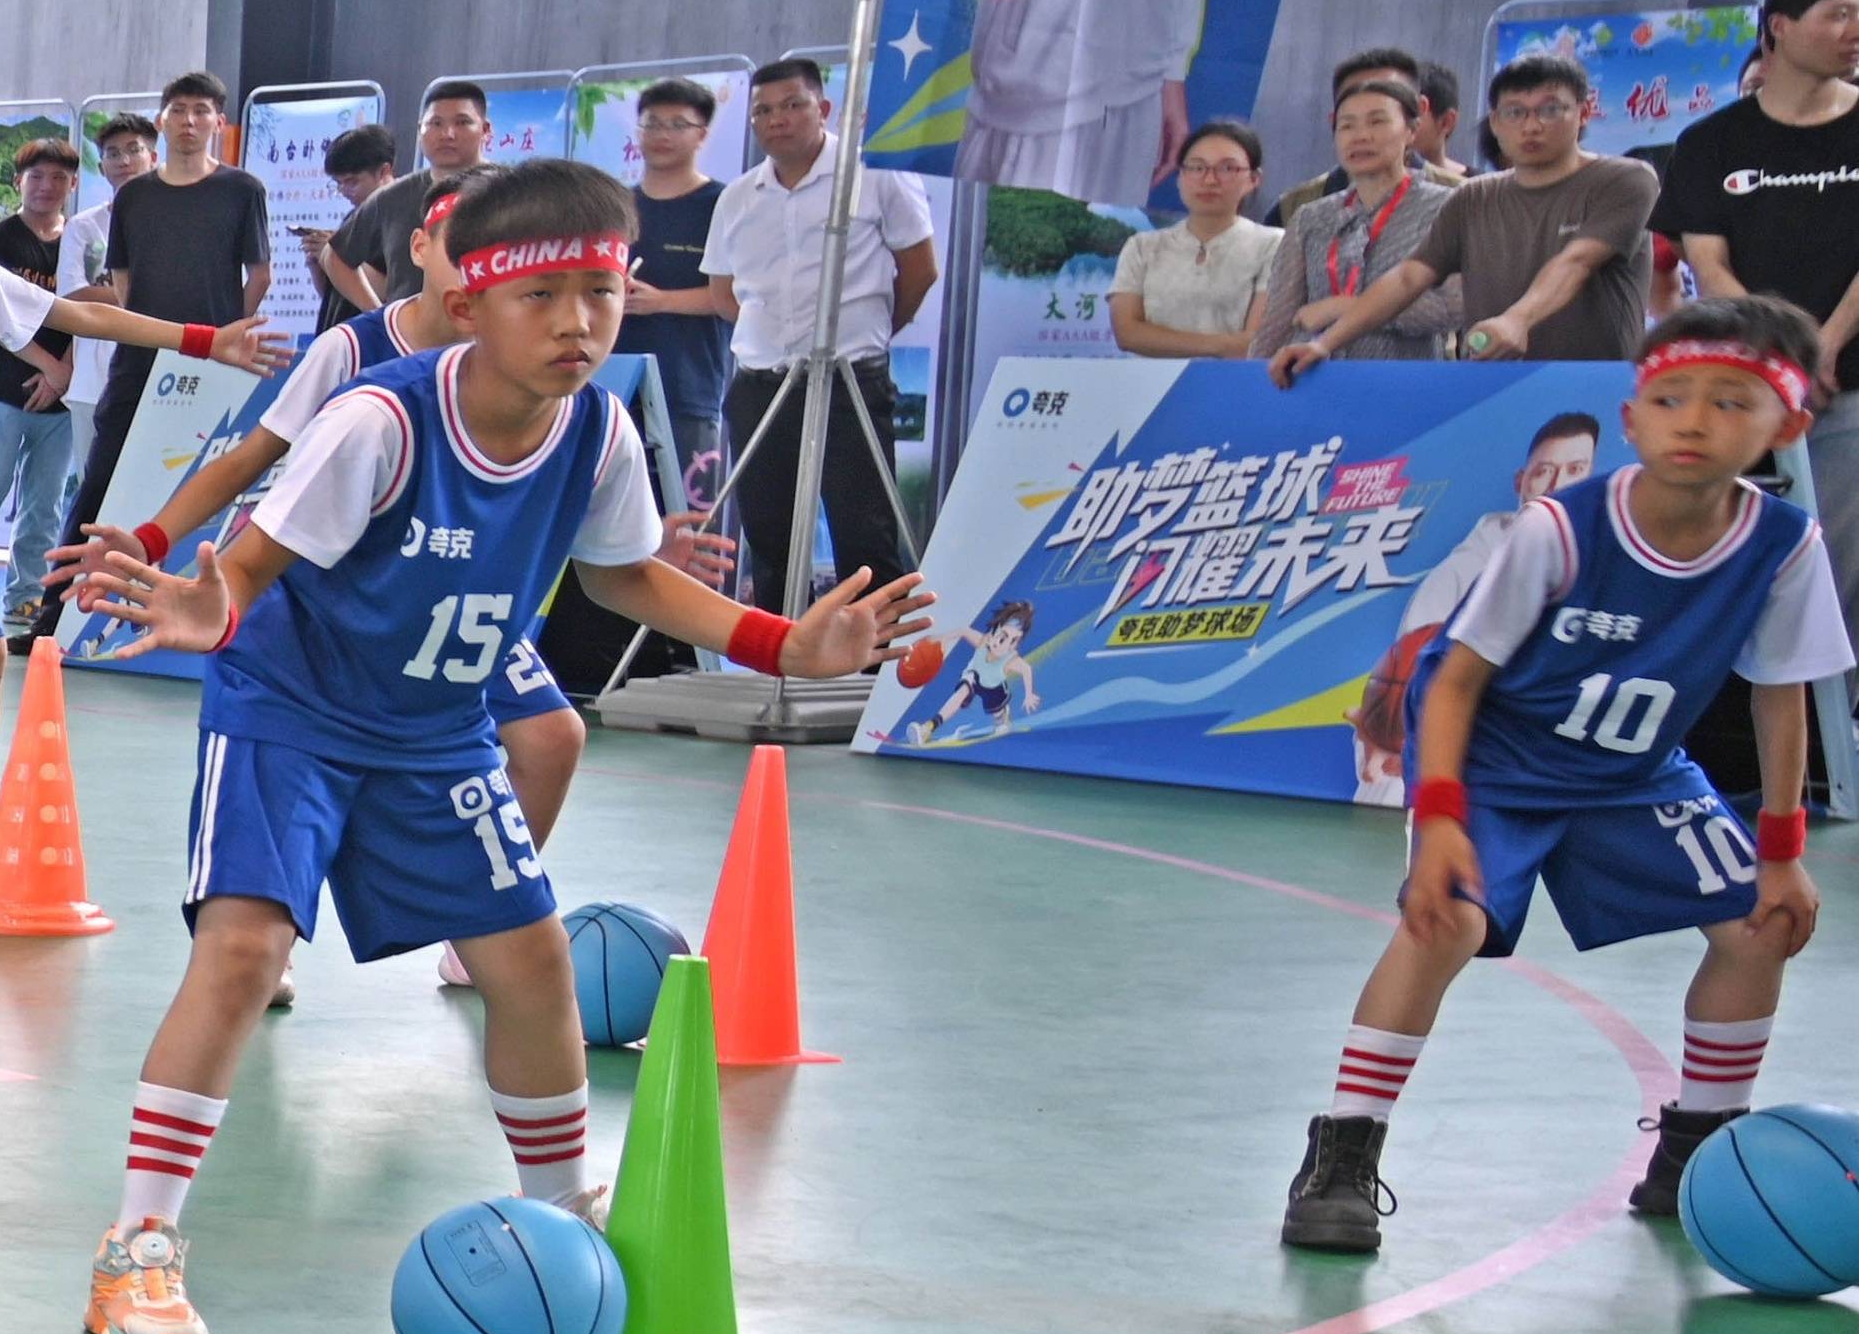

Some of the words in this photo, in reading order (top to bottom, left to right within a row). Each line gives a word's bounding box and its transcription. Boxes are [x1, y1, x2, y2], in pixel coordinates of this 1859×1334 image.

[490, 237, 583, 275] CHINA
[177, 375, 201, 396] 夸克
[1032, 390, 1070, 416] 夸克
[1045, 435, 1342, 578] 助梦篮球
[428, 528, 475, 560] 夸克
[1094, 505, 1425, 629] 闪耀未来
[403, 594, 513, 683] 15
[1117, 606, 1261, 641] 夸克助梦球场
[1586, 611, 1642, 643] 夸克
[1553, 672, 1677, 754] 10
[474, 801, 542, 891] 15
[1675, 815, 1757, 896] 10
